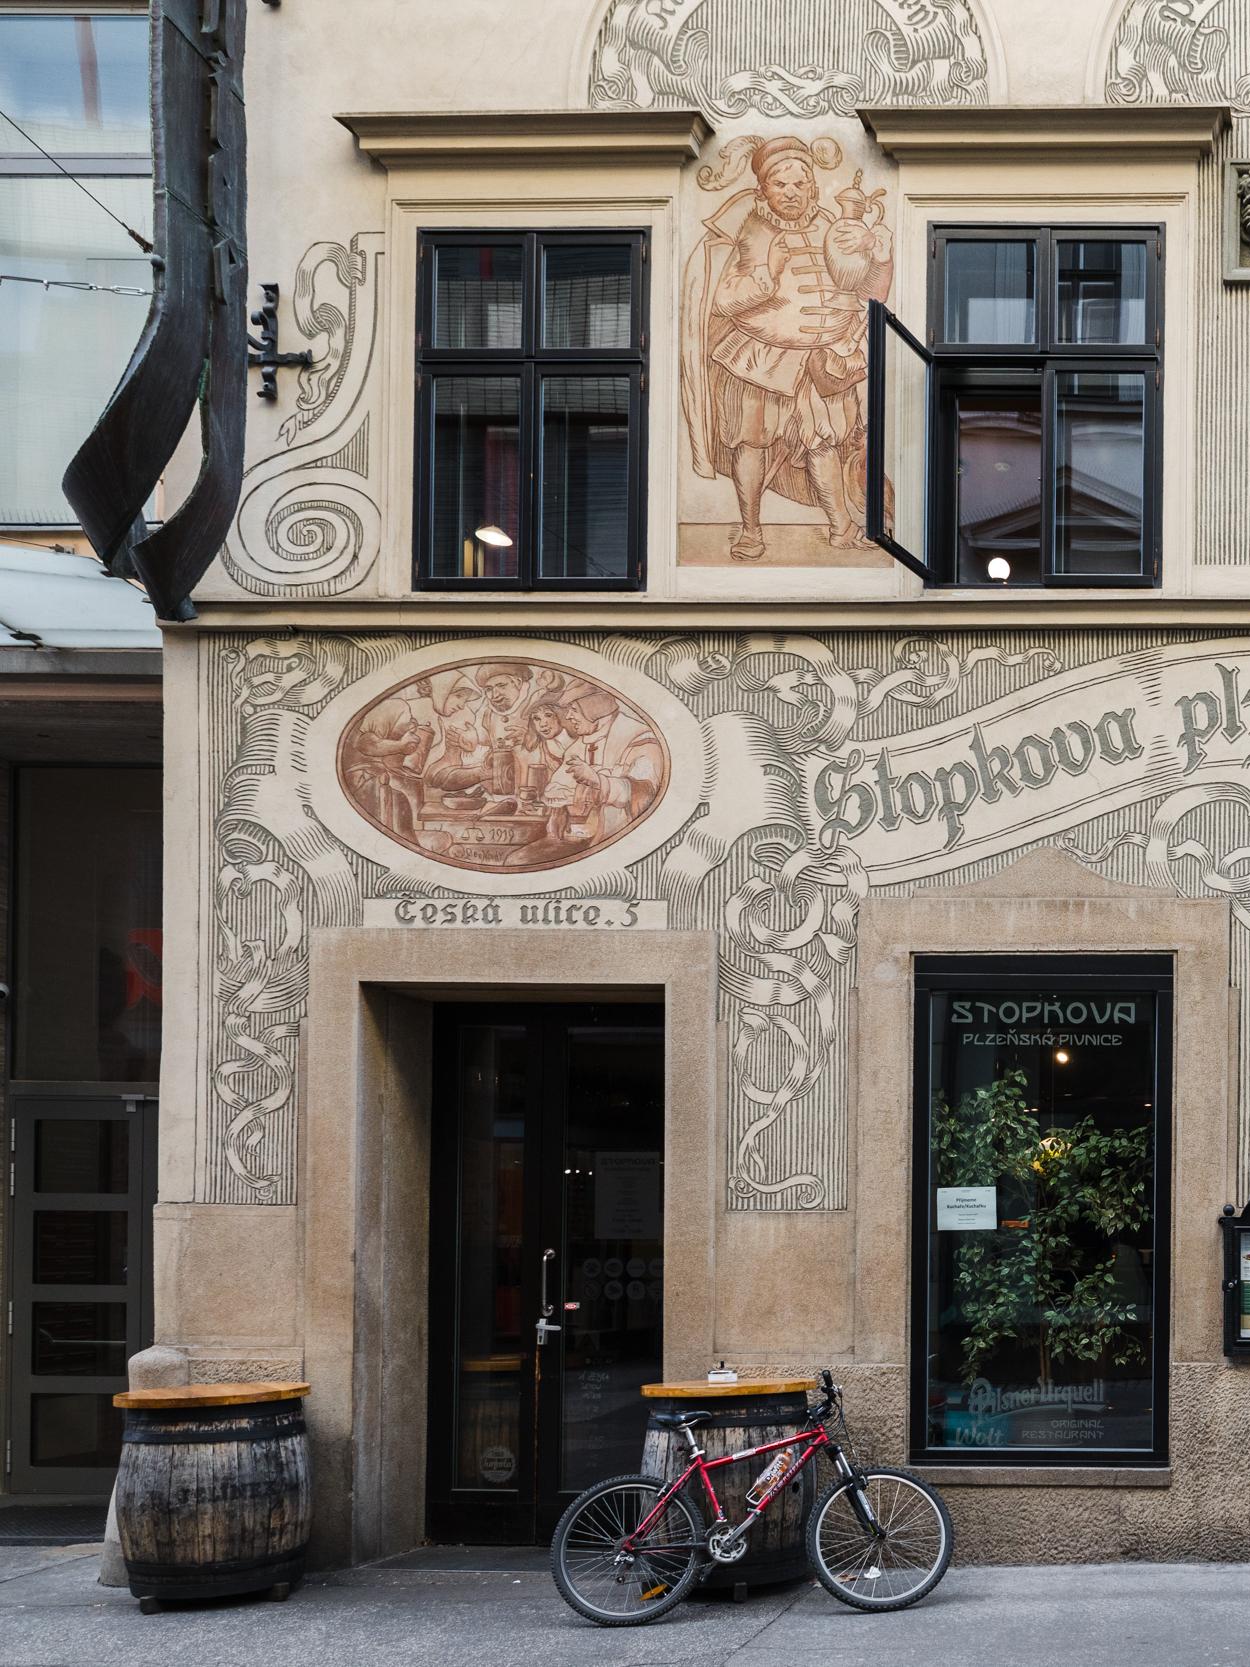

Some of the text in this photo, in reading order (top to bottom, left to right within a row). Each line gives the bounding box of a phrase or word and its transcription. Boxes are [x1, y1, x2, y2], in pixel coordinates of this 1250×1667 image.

[814, 707, 1145, 853] Stopkova
[394, 893, 502, 925] Česká
[951, 1001, 1136, 1024] STOPKOVA
[963, 1028, 1123, 1046] PLZEŇSKÁ PIVNICE
